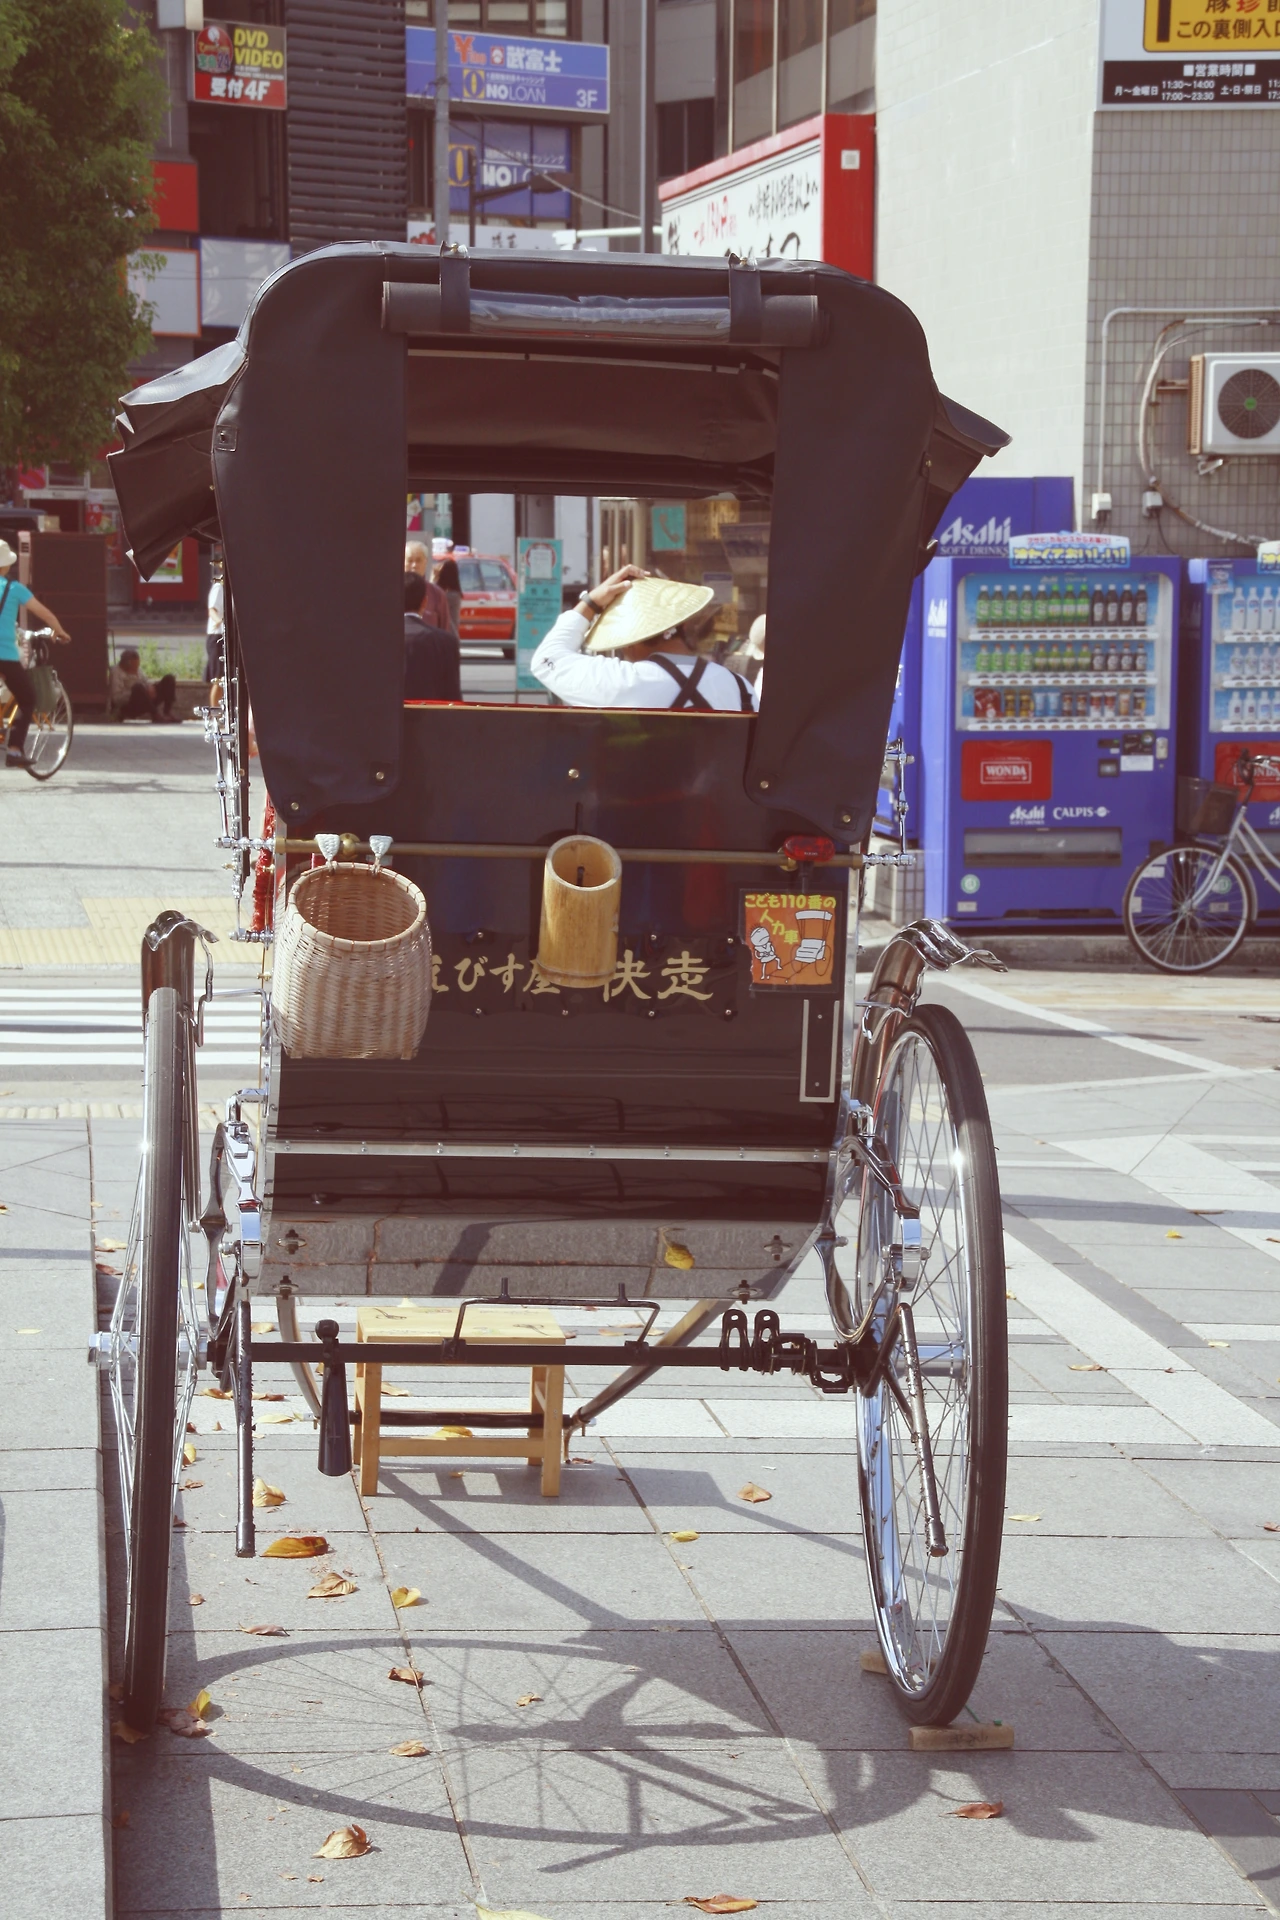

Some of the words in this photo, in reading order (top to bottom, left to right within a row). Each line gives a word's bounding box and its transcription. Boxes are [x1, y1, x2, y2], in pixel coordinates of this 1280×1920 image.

[234, 28, 269, 49] DVD
[234, 47, 284, 69] VIDEO
[506, 46, 563, 73] 武富士
[576, 88, 598, 108] 3F
[940, 516, 1011, 545] Asahi
[941, 546, 967, 555] SOFT
[970, 546, 1009, 556] DRINKS
[985, 764, 1027, 776] WONDA
[1010, 805, 1045, 820] Asahi
[1053, 806, 1093, 820] CALPIS
[745, 893, 836, 909] こども110番の
[760, 909, 798, 944] 人力車
[602, 948, 713, 1003] 快走
